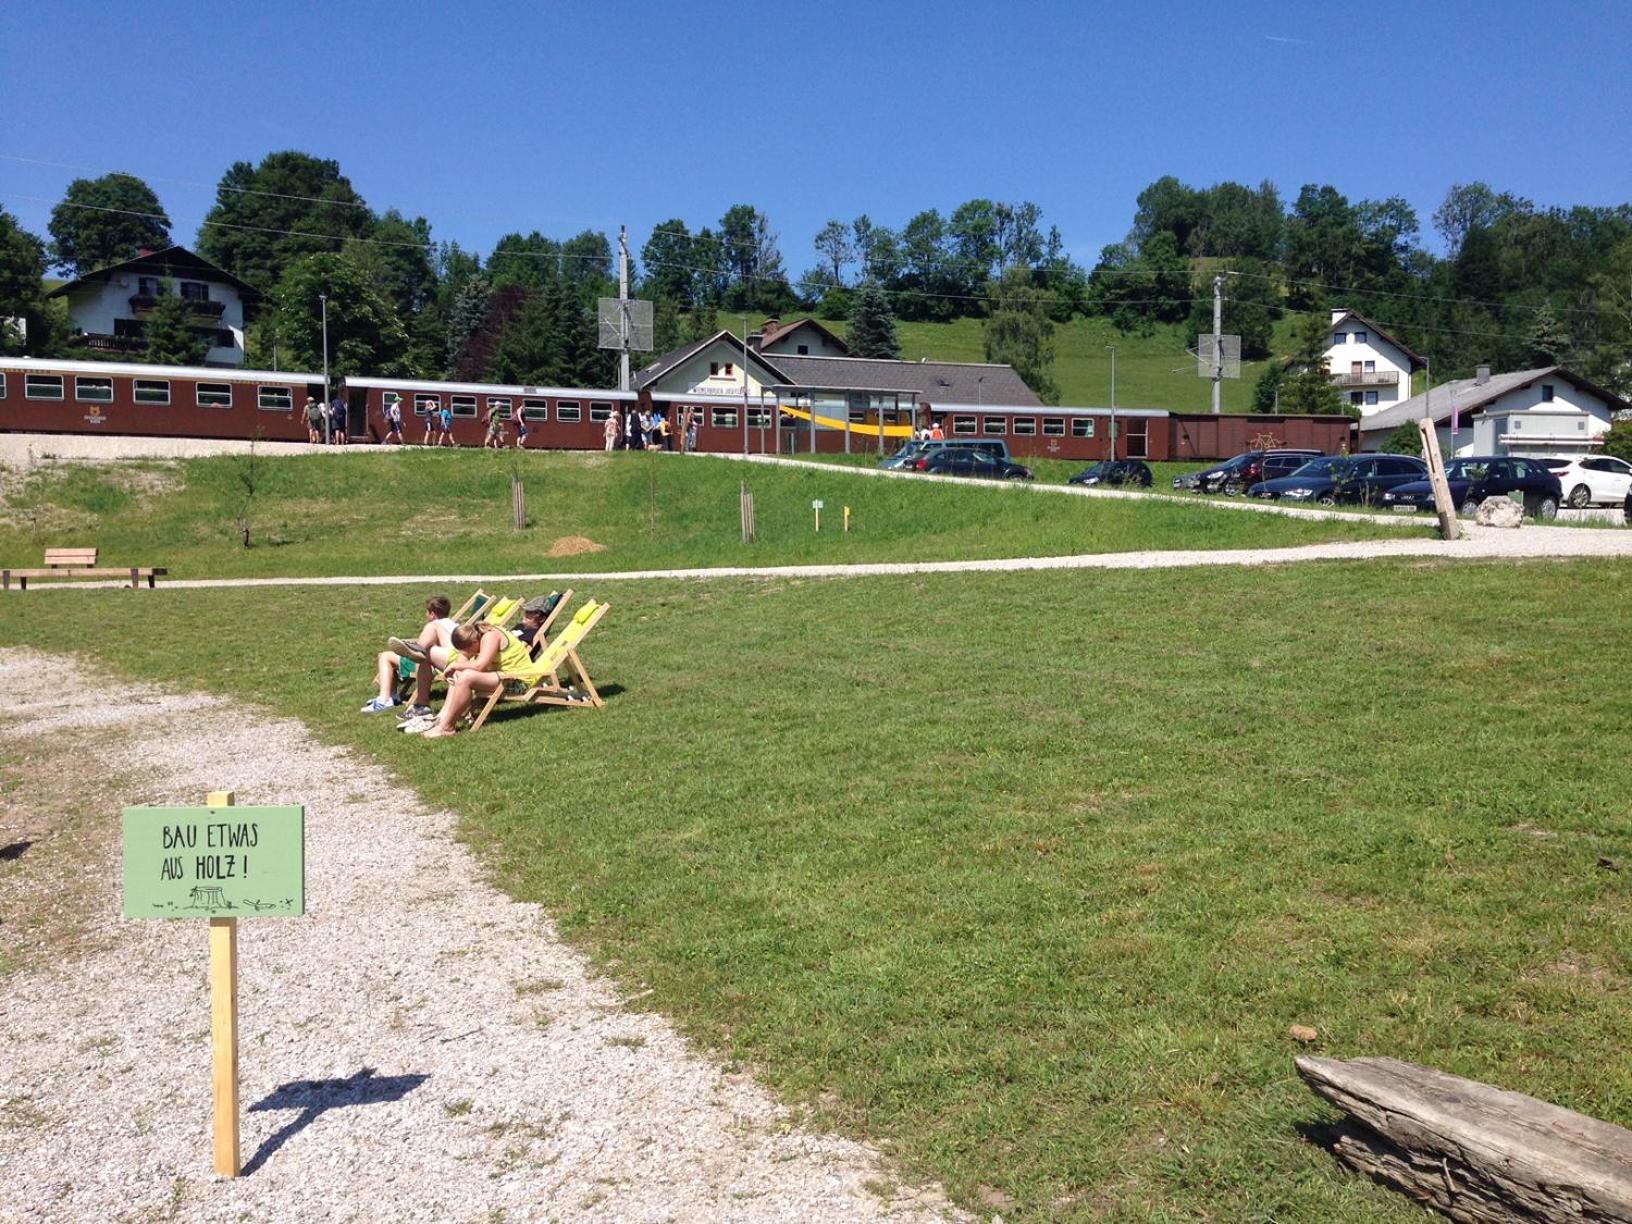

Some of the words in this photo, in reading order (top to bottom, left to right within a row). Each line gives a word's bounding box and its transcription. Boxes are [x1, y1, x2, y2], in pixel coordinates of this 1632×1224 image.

[162, 824, 197, 849] BAU
[207, 823, 258, 848] ETWAS
[160, 856, 184, 880] AUS
